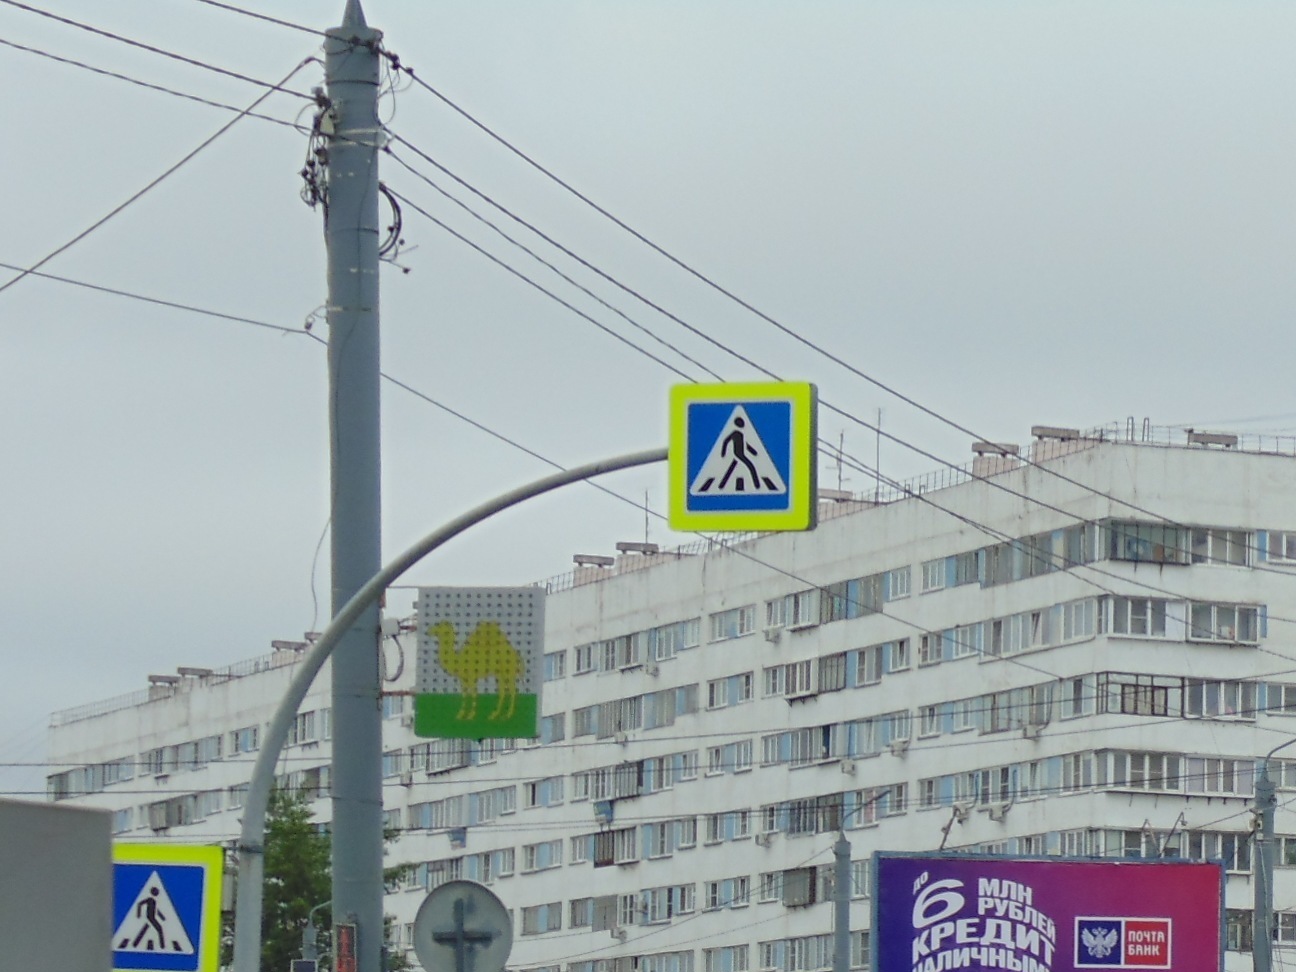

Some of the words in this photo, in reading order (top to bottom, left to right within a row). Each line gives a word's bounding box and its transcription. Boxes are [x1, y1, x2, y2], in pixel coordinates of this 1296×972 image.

[912, 871, 929, 895] ДО
[978, 877, 1033, 905] МЛН
[912, 879, 965, 929] 6
[977, 897, 1056, 944] РУБЛЕЙ
[912, 918, 1056, 967] КРЕДИТ
[1128, 930, 1165, 943] ПОЧТА
[1128, 944, 1160, 956] БАНК
